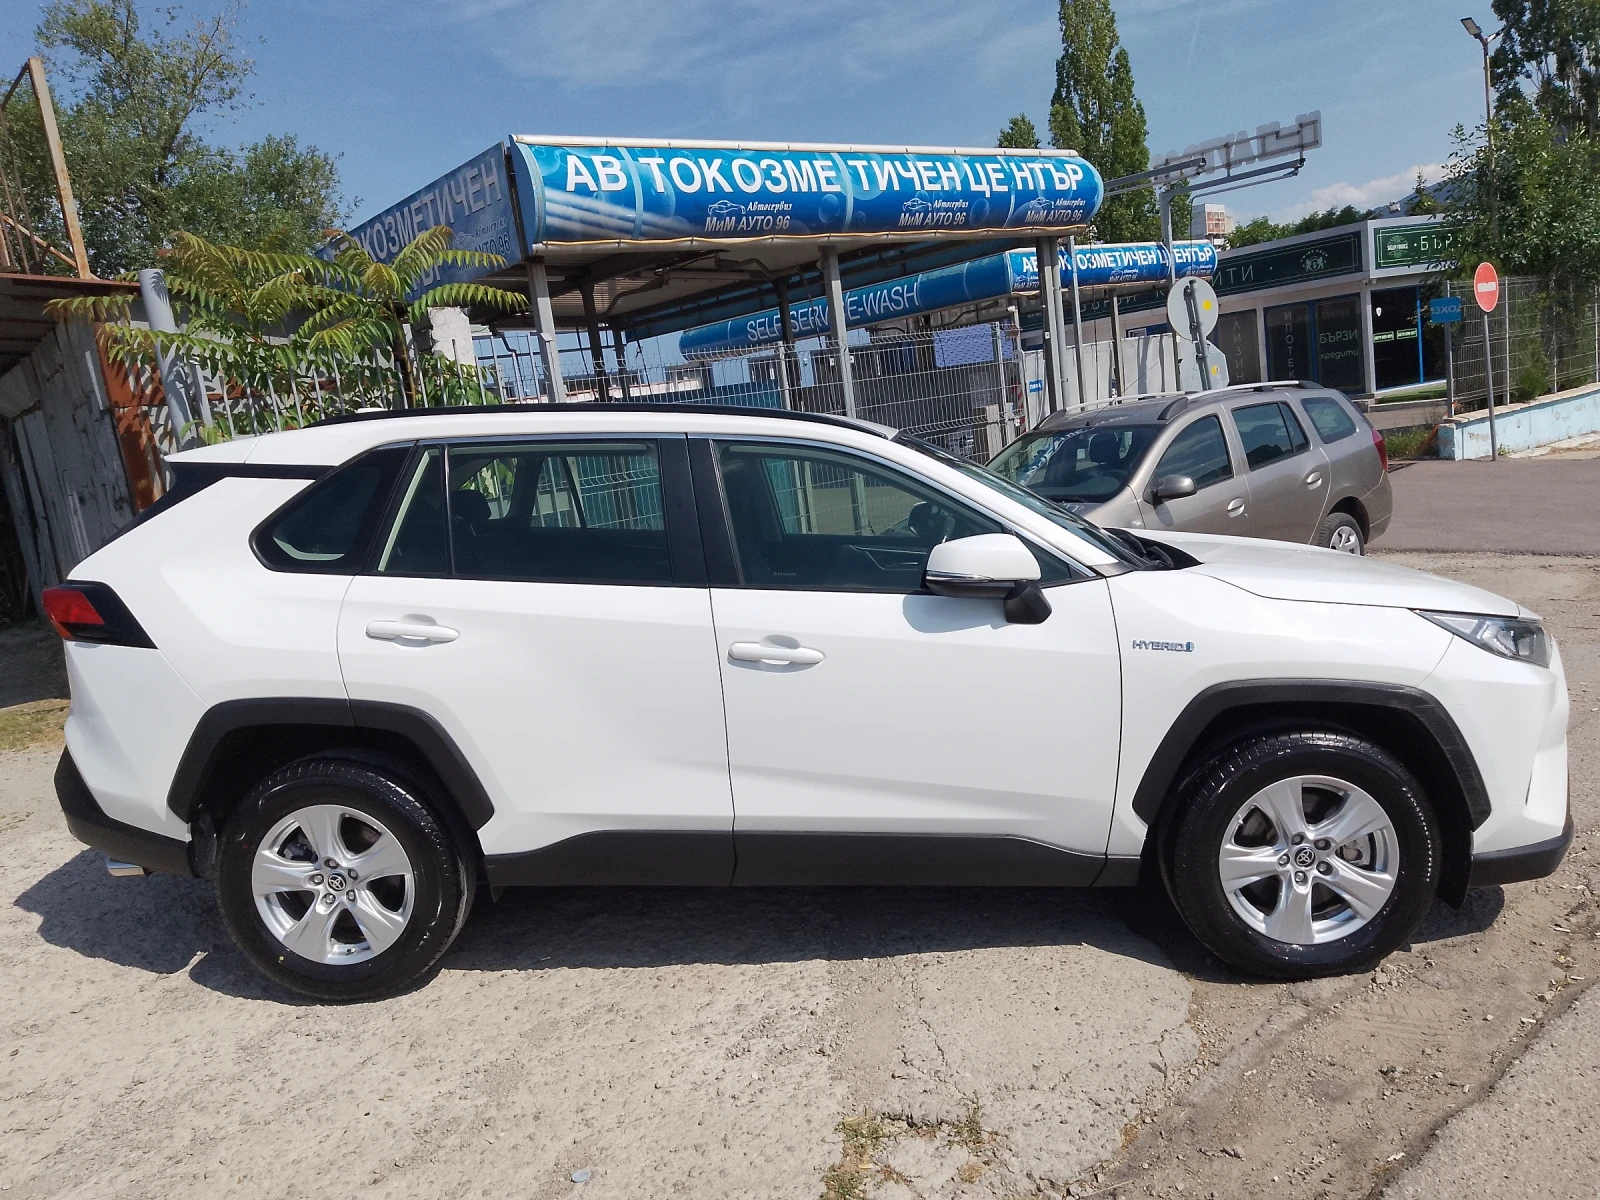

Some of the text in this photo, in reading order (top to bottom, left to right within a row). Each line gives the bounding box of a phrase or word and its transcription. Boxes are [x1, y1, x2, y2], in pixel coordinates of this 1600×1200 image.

[746, 201, 793, 213] Автосервиз
[932, 198, 969, 210] Автосервиз
[1055, 197, 1086, 208] Автосервиз
[323, 157, 502, 286] КОЗМЕТИЧЕН
[898, 211, 967, 226] МиМ АУТО 96
[1071, 209, 1083, 222] 96
[704, 215, 791, 232] МиМ АУТО 96
[498, 231, 512, 256] 96
[1319, 329, 1359, 345] БЪРЗИ
[1283, 311, 1297, 381] ИПОТЕК
[1320, 348, 1359, 360] кредити
[1132, 639, 1185, 652] HYBRID
